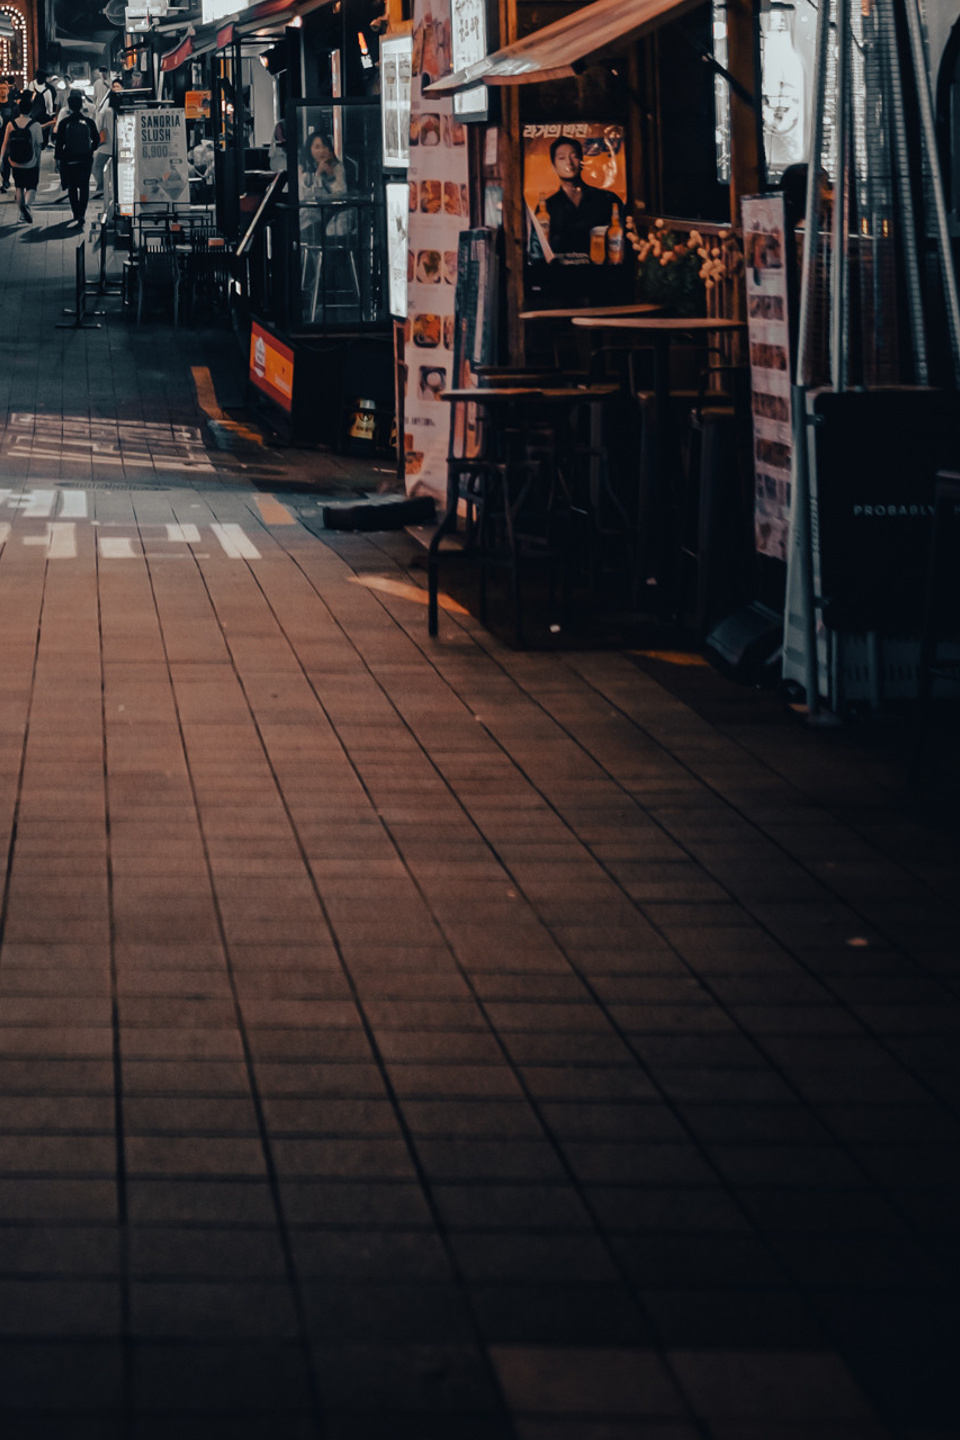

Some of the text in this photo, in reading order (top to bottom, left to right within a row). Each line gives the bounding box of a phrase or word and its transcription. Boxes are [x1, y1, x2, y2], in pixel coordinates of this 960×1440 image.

[141, 115, 181, 128] SANGRIA
[141, 129, 171, 142] SLUSH
[522, 124, 561, 138] 라거의
[852, 504, 935, 516] PROBABLY
